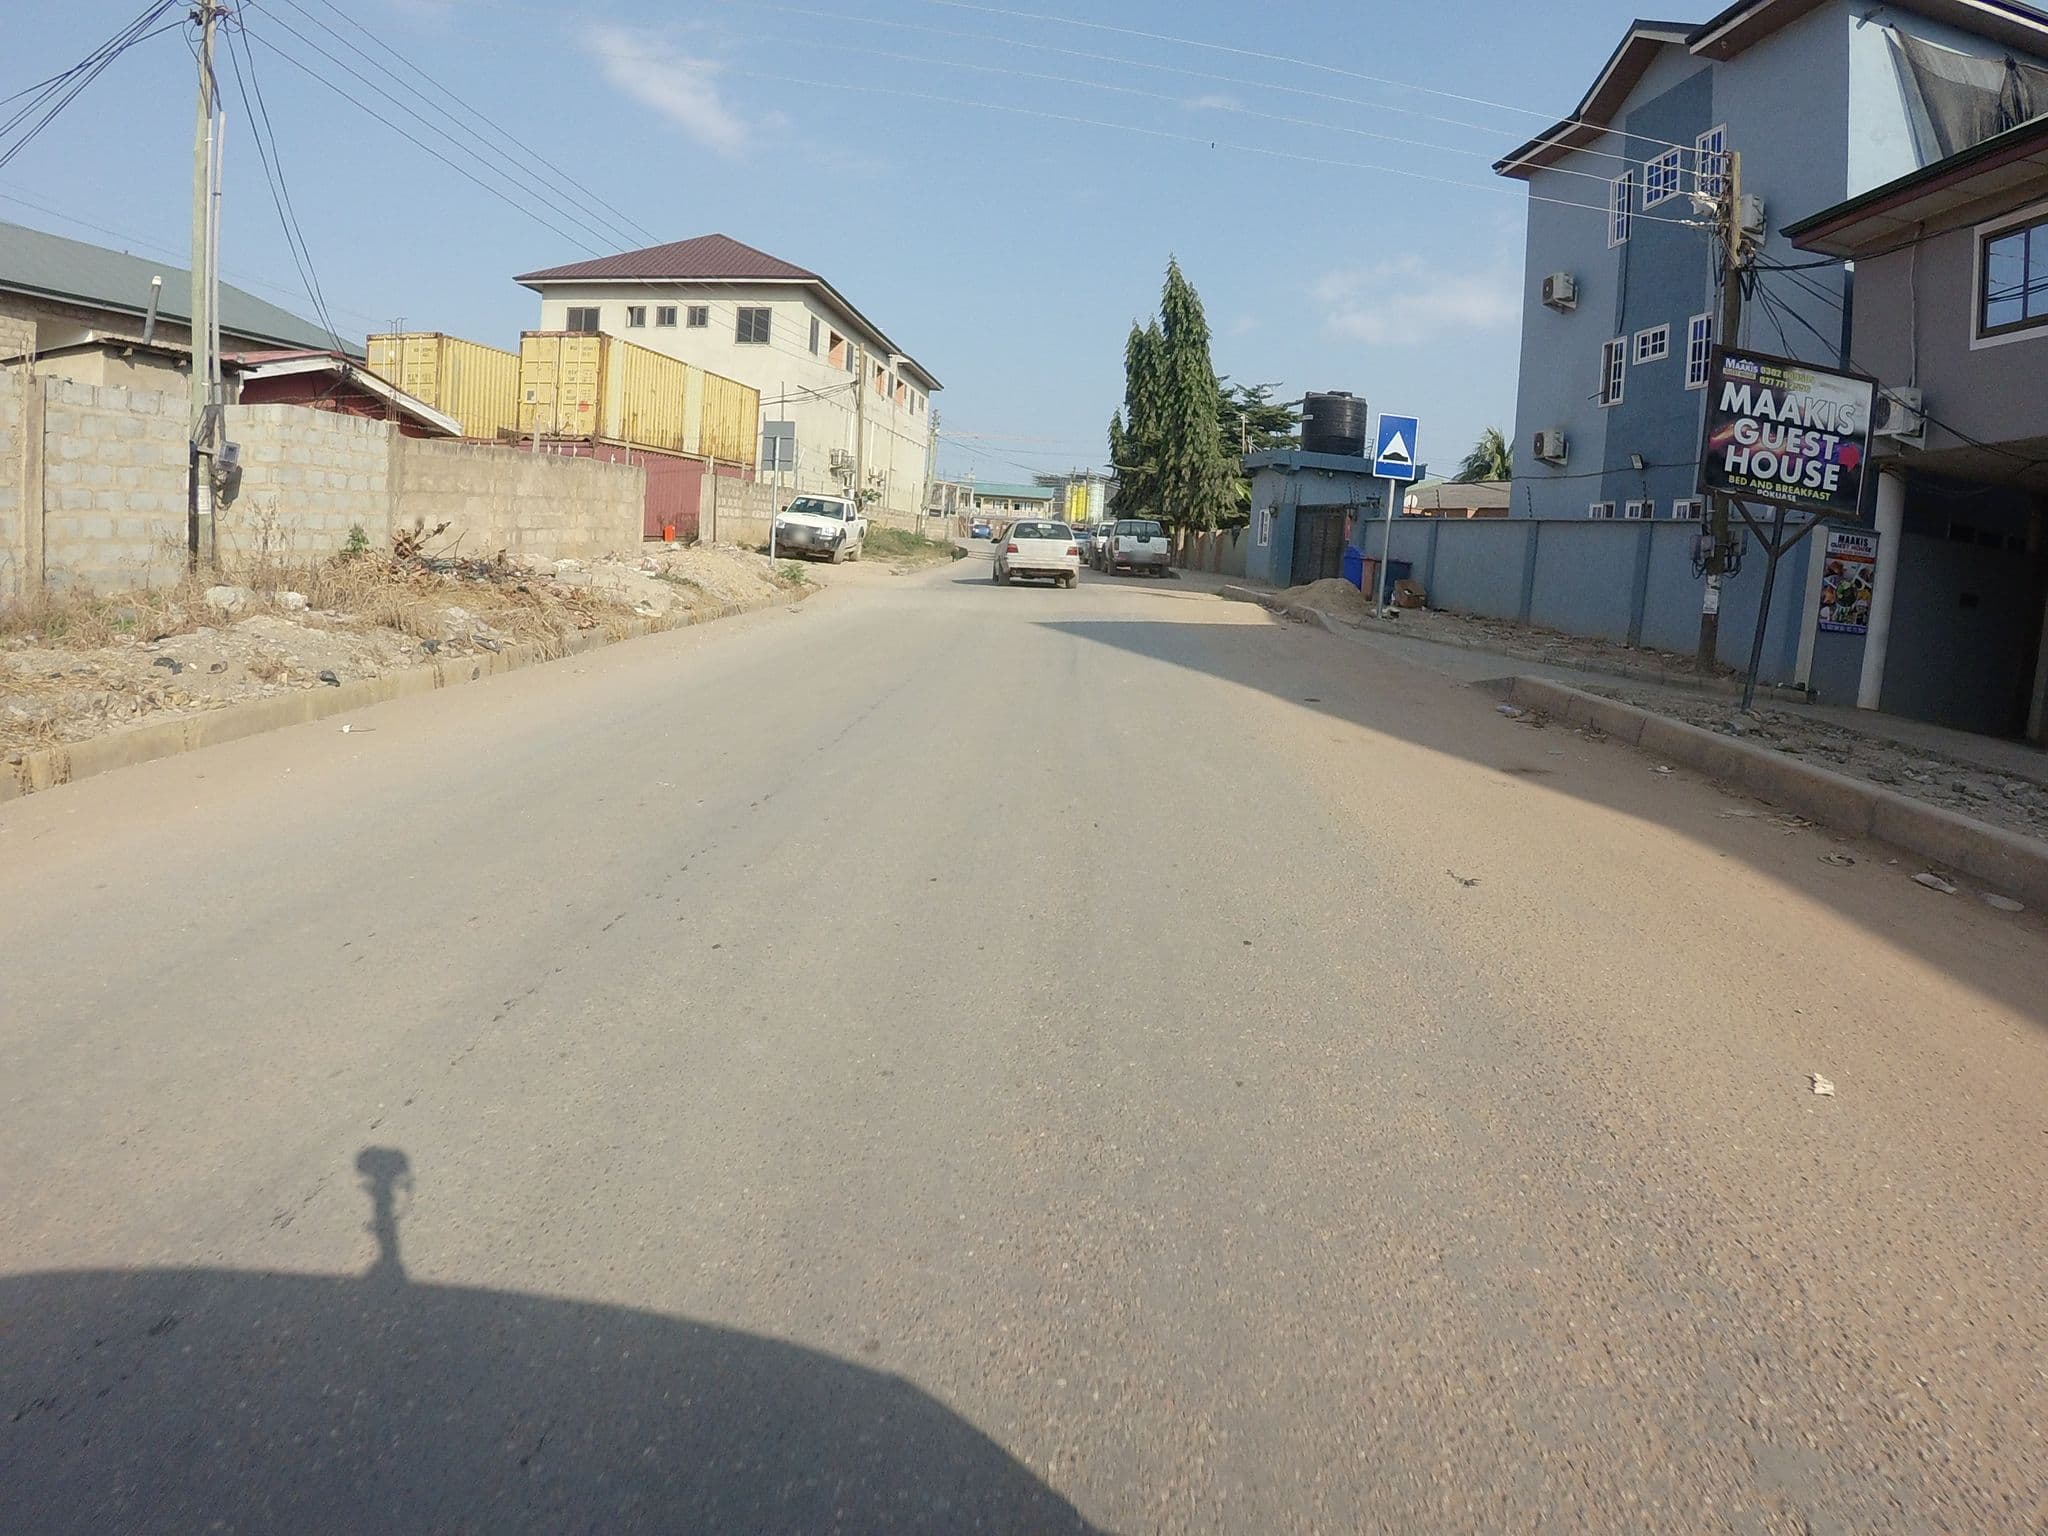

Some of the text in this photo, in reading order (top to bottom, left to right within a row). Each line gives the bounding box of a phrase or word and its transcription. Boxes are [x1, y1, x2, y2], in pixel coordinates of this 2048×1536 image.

[1725, 358, 1759, 373] MAAKIS
[1719, 381, 1856, 436] MAAKIS
[1733, 418, 1840, 461] GUEST
[1724, 445, 1841, 491] HOUSE
[1728, 475, 1831, 501] BED AND BREAKFAST
[1838, 534, 1869, 547] MAAKIS
